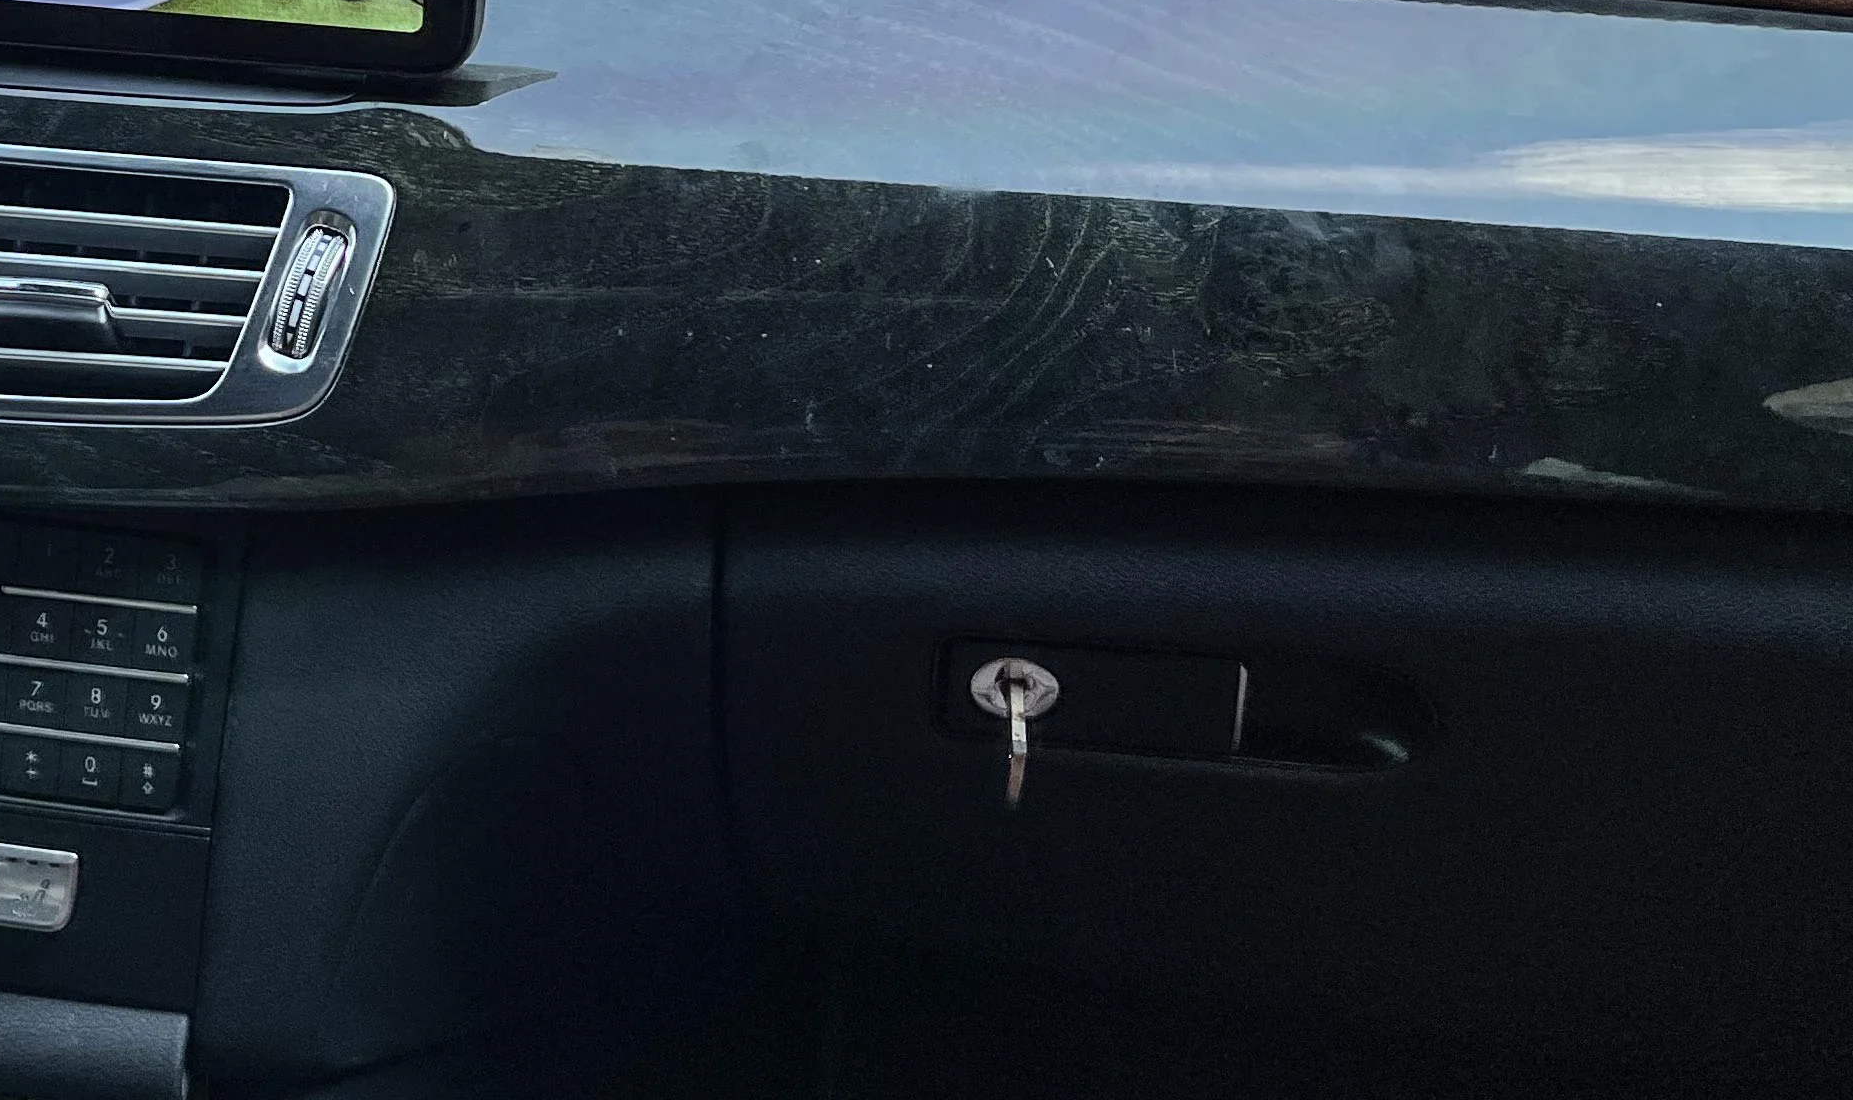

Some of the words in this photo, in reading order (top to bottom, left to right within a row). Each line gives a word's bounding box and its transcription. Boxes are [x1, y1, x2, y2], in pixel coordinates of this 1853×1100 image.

[104, 547, 114, 564] 2
[165, 554, 177, 570] 3
[36, 611, 48, 627] 4
[96, 618, 109, 636] 5
[156, 626, 168, 642] 6
[145, 643, 178, 659] MNO
[30, 681, 44, 697] 7
[90, 687, 102, 704] 8
[150, 694, 162, 711] 9
[138, 712, 173, 727] WXYZ
[84, 756, 96, 773] 0
